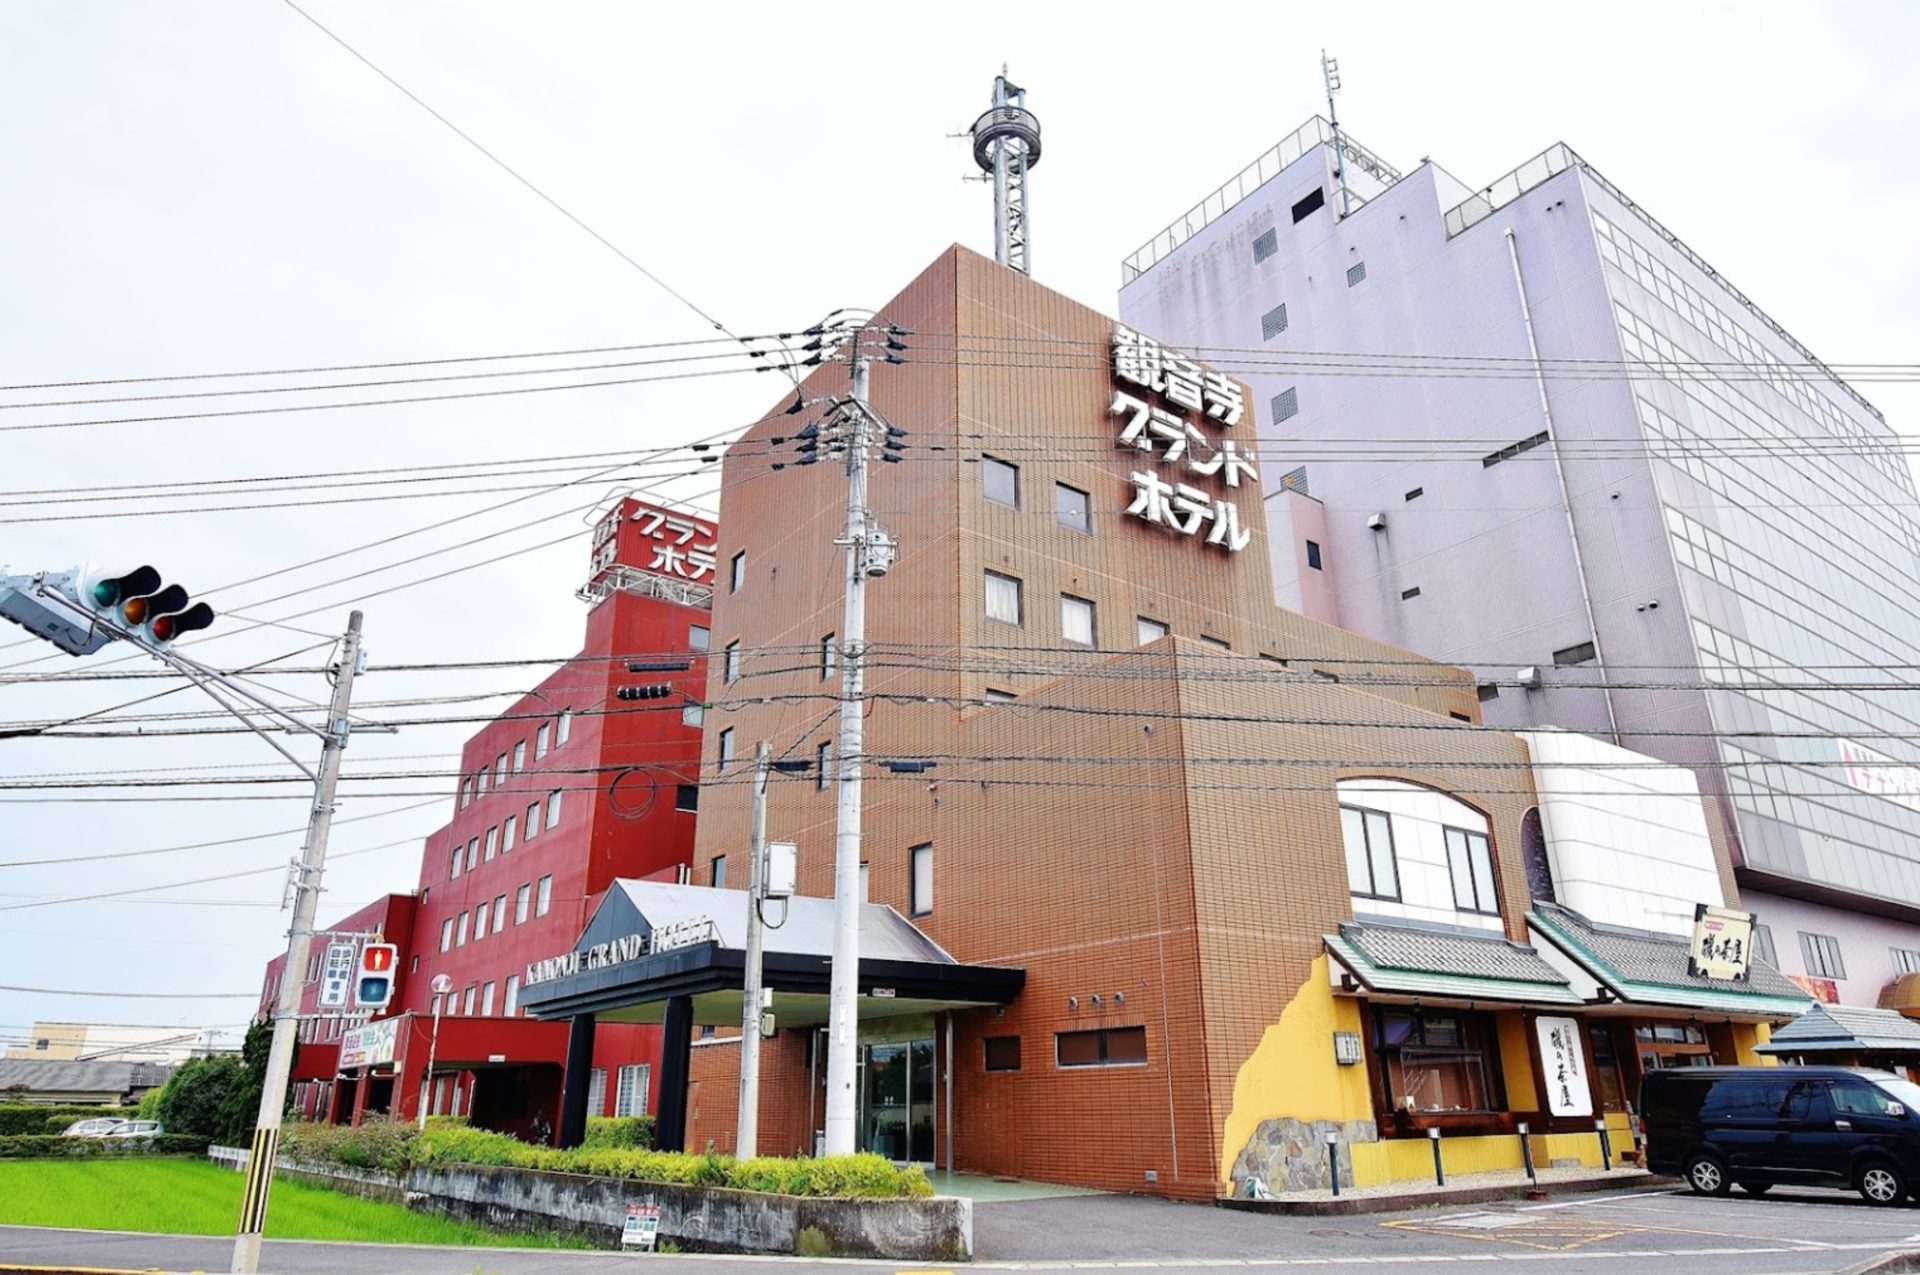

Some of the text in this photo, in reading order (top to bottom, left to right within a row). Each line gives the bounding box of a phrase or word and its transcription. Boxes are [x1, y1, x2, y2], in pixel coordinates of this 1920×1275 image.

[1113, 326, 1244, 426] 観音寺
[1109, 390, 1258, 487] グランド
[1124, 469, 1250, 552] ホテル
[588, 934, 642, 970] GRAND
